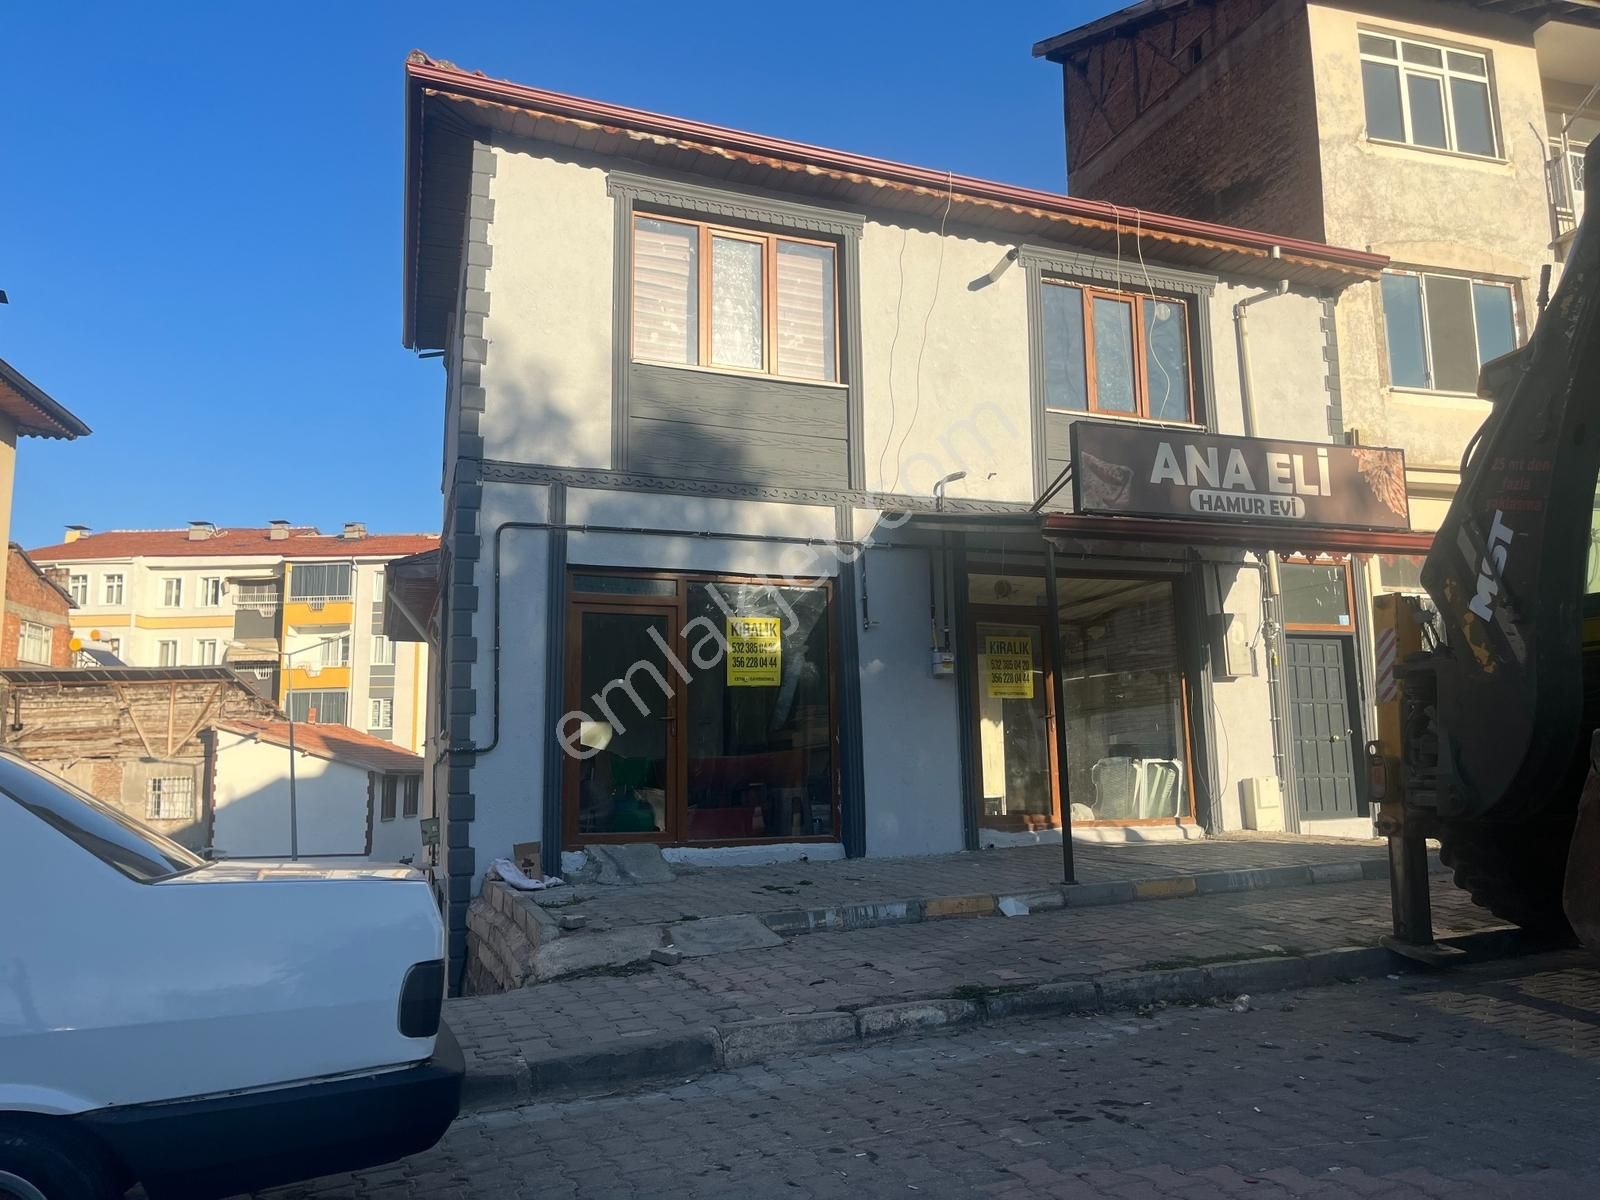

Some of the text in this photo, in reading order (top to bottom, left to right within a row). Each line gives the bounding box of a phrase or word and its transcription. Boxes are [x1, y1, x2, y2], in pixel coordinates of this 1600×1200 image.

[1150, 441, 1332, 497] ANA ELİ
[1199, 493, 1297, 518] HAMUR EVİ
[1468, 509, 1514, 623] MST
[731, 642, 744, 654] 532
[745, 642, 758, 654] 385
[731, 656, 777, 668] 356 228 04 44
